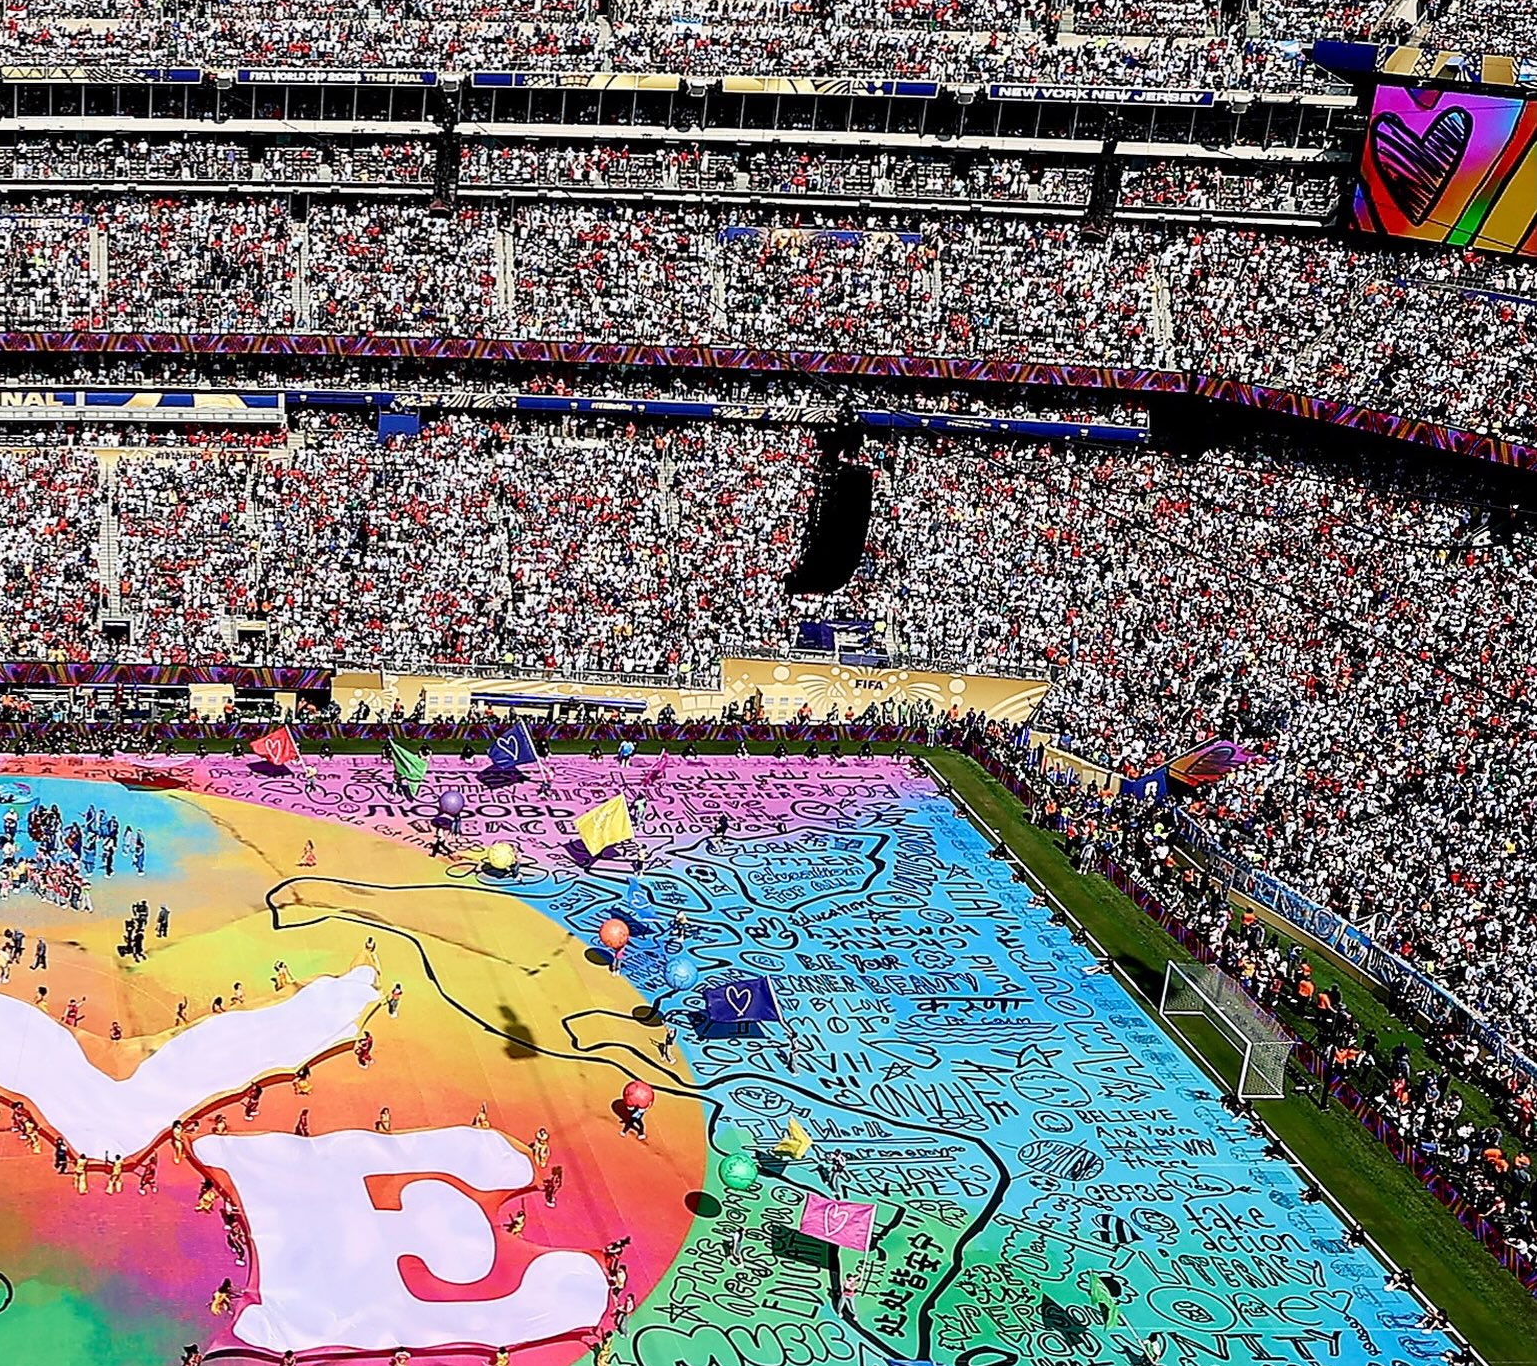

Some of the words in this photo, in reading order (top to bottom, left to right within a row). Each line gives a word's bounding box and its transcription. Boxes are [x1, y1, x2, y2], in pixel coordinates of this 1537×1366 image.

[999, 87, 1038, 98] NEW
[1041, 88, 1089, 99] YORK
[1091, 89, 1129, 101] NEW
[1133, 90, 1204, 104] JERSEY
[855, 679, 883, 690] FIFA
